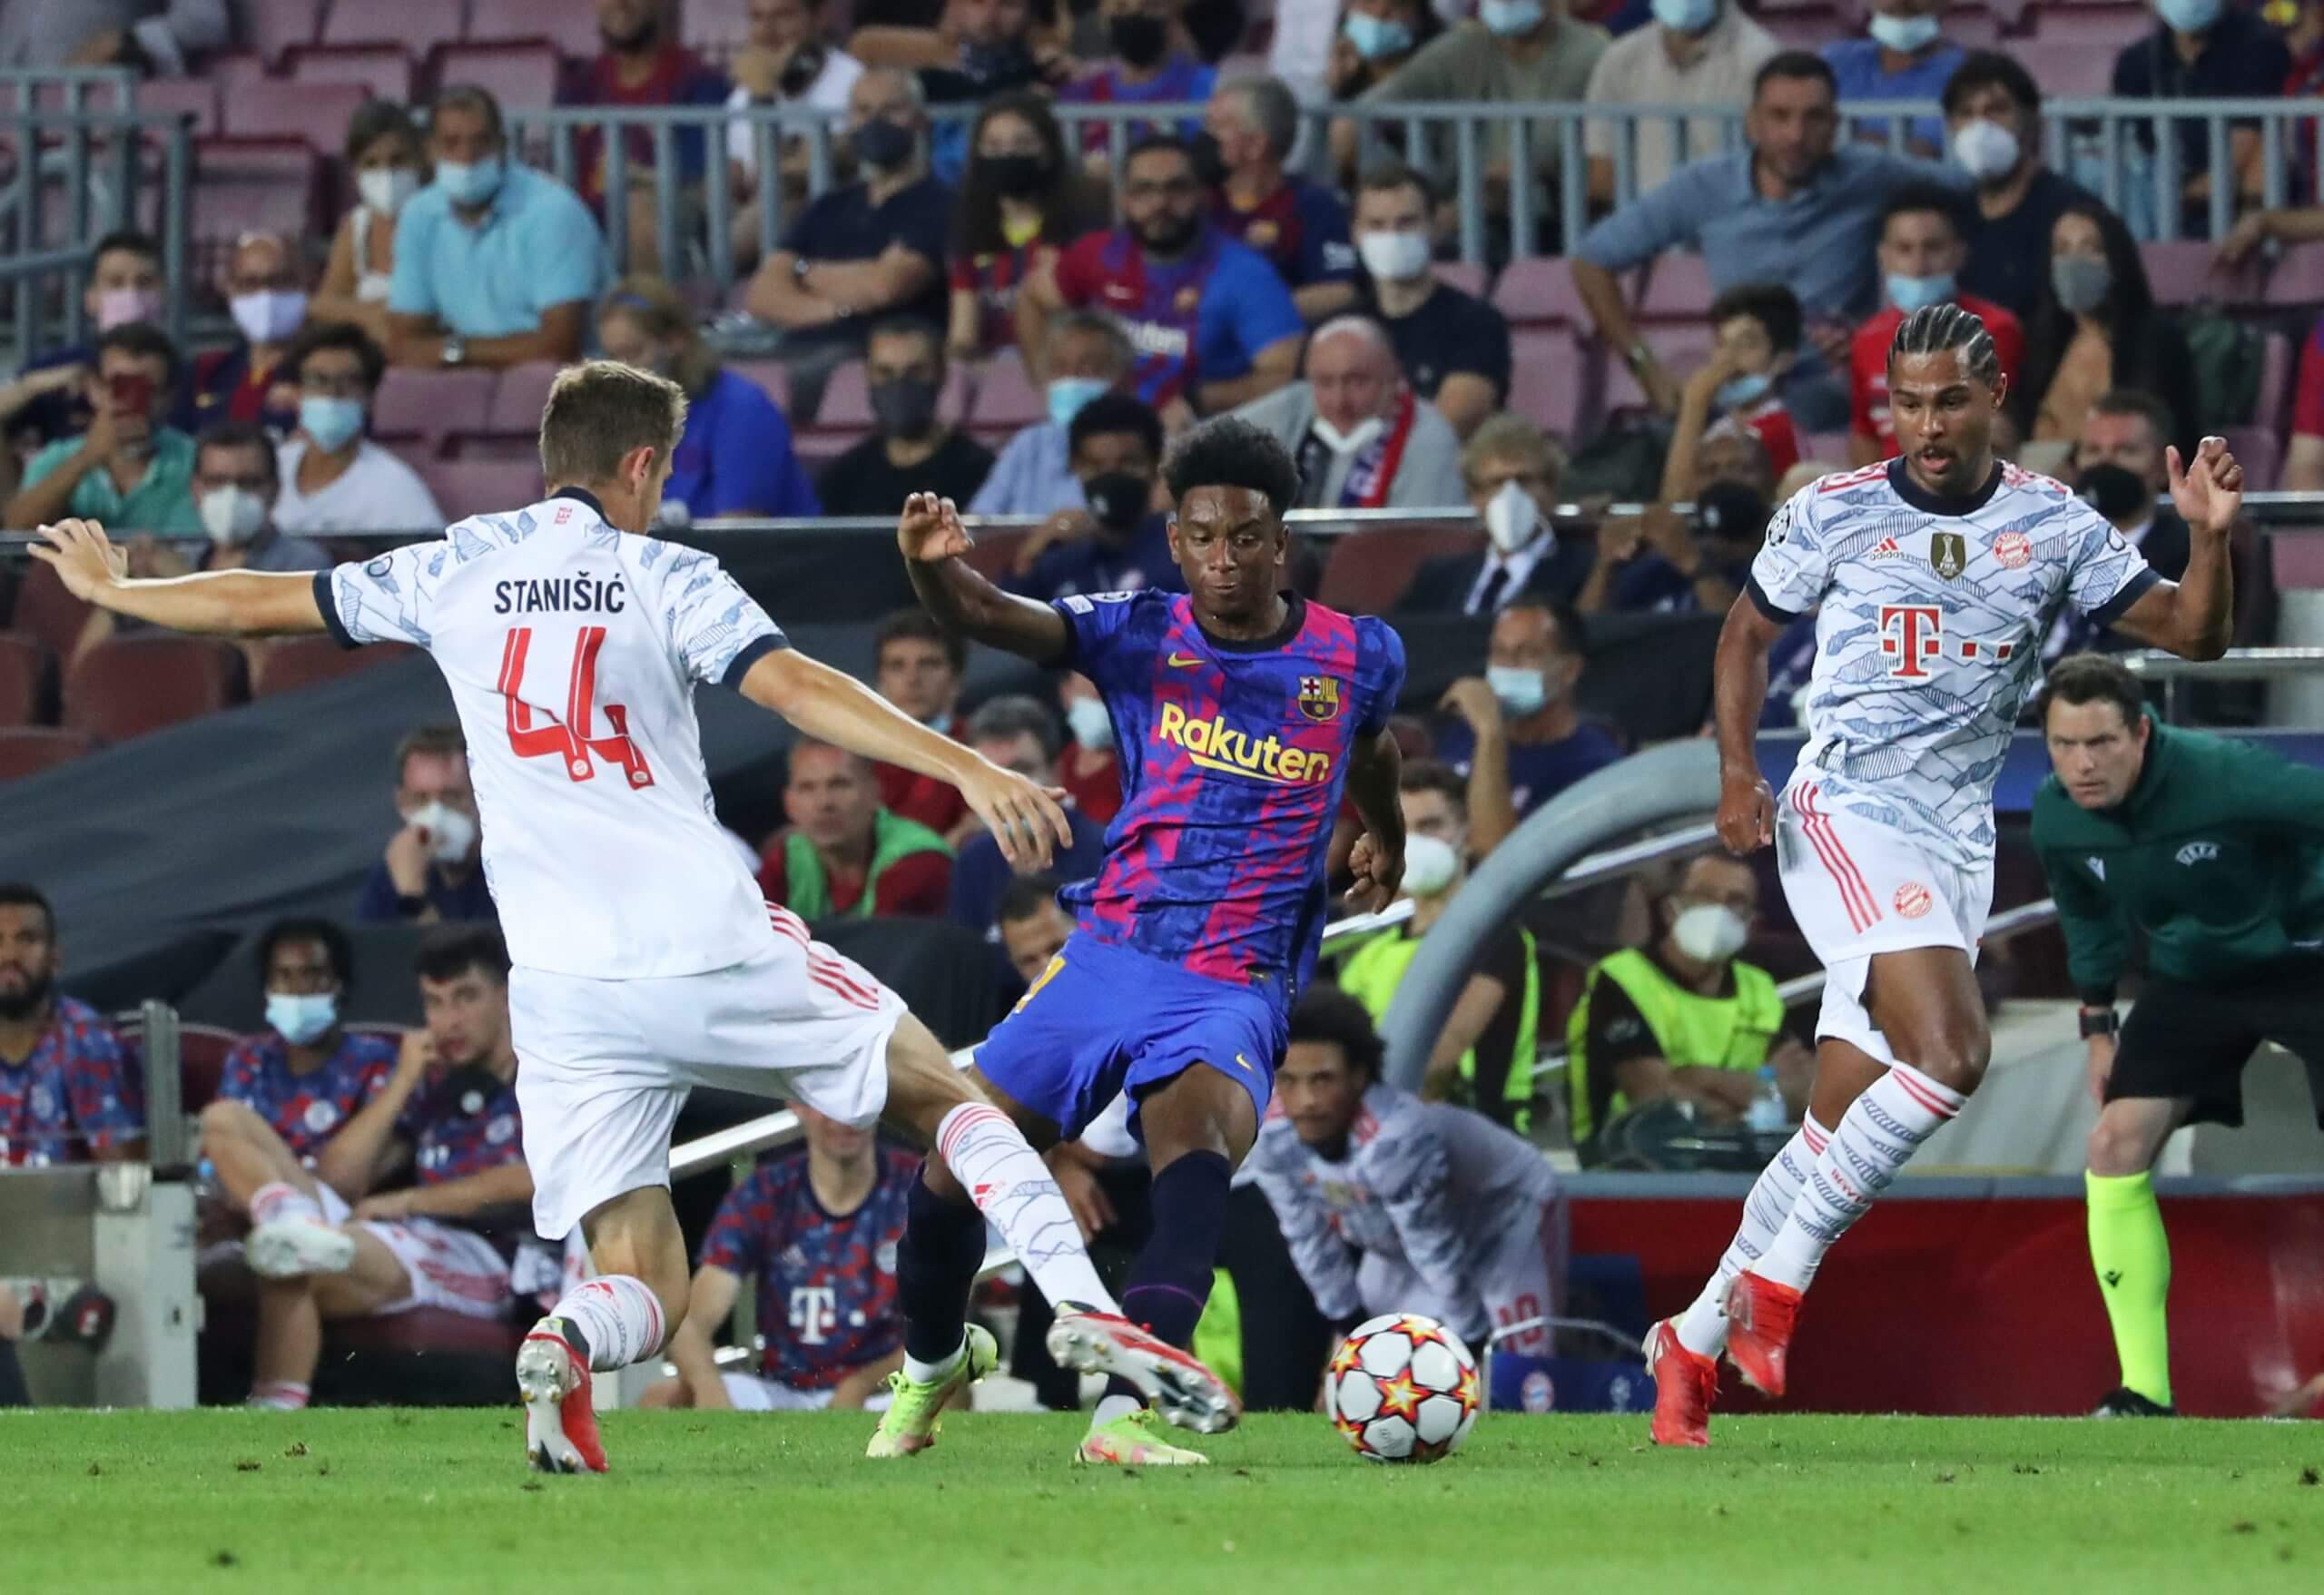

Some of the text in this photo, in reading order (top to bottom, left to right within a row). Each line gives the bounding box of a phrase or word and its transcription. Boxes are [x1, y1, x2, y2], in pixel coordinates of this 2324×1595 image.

[494, 570, 625, 614] STANIŠIĆ
[1880, 605, 1941, 678] T
[497, 626, 655, 791] 44
[1158, 701, 1329, 782] Rakuten
[789, 1285, 836, 1345] T
[1498, 1291, 1544, 1354] 10
